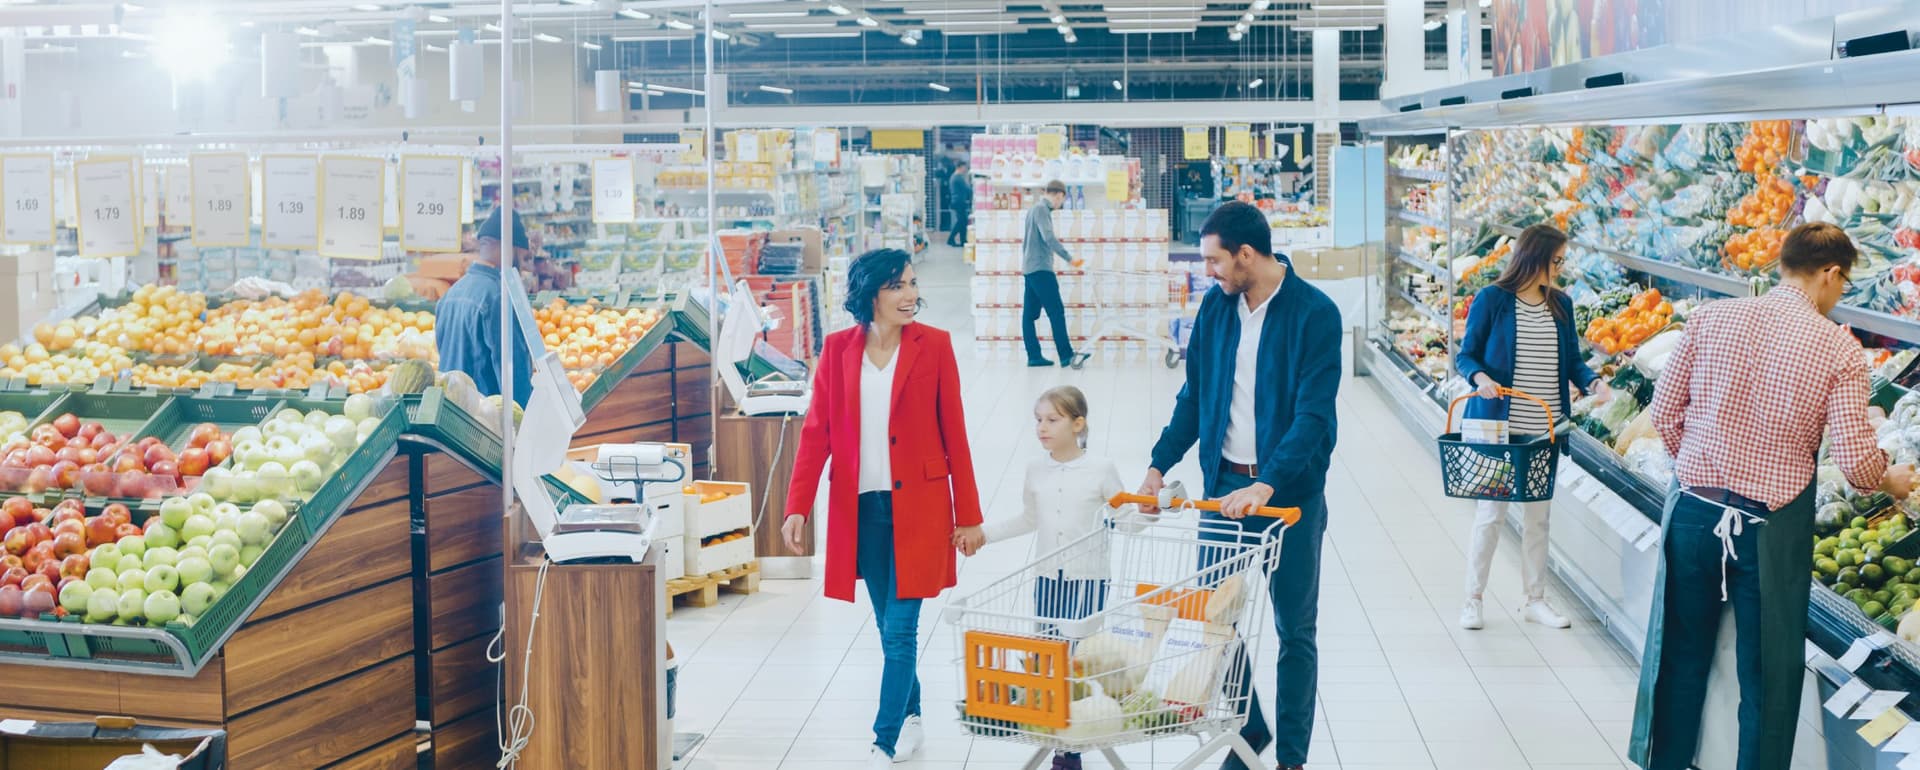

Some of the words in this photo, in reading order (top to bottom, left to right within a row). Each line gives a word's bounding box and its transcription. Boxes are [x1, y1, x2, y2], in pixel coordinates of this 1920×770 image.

[16, 199, 39, 211] 1.69
[207, 199, 232, 212] 1.89
[278, 201, 304, 214] 1.39
[416, 202, 444, 216] 2.99
[94, 207, 120, 220] 1.79
[338, 206, 365, 221] 1.89
